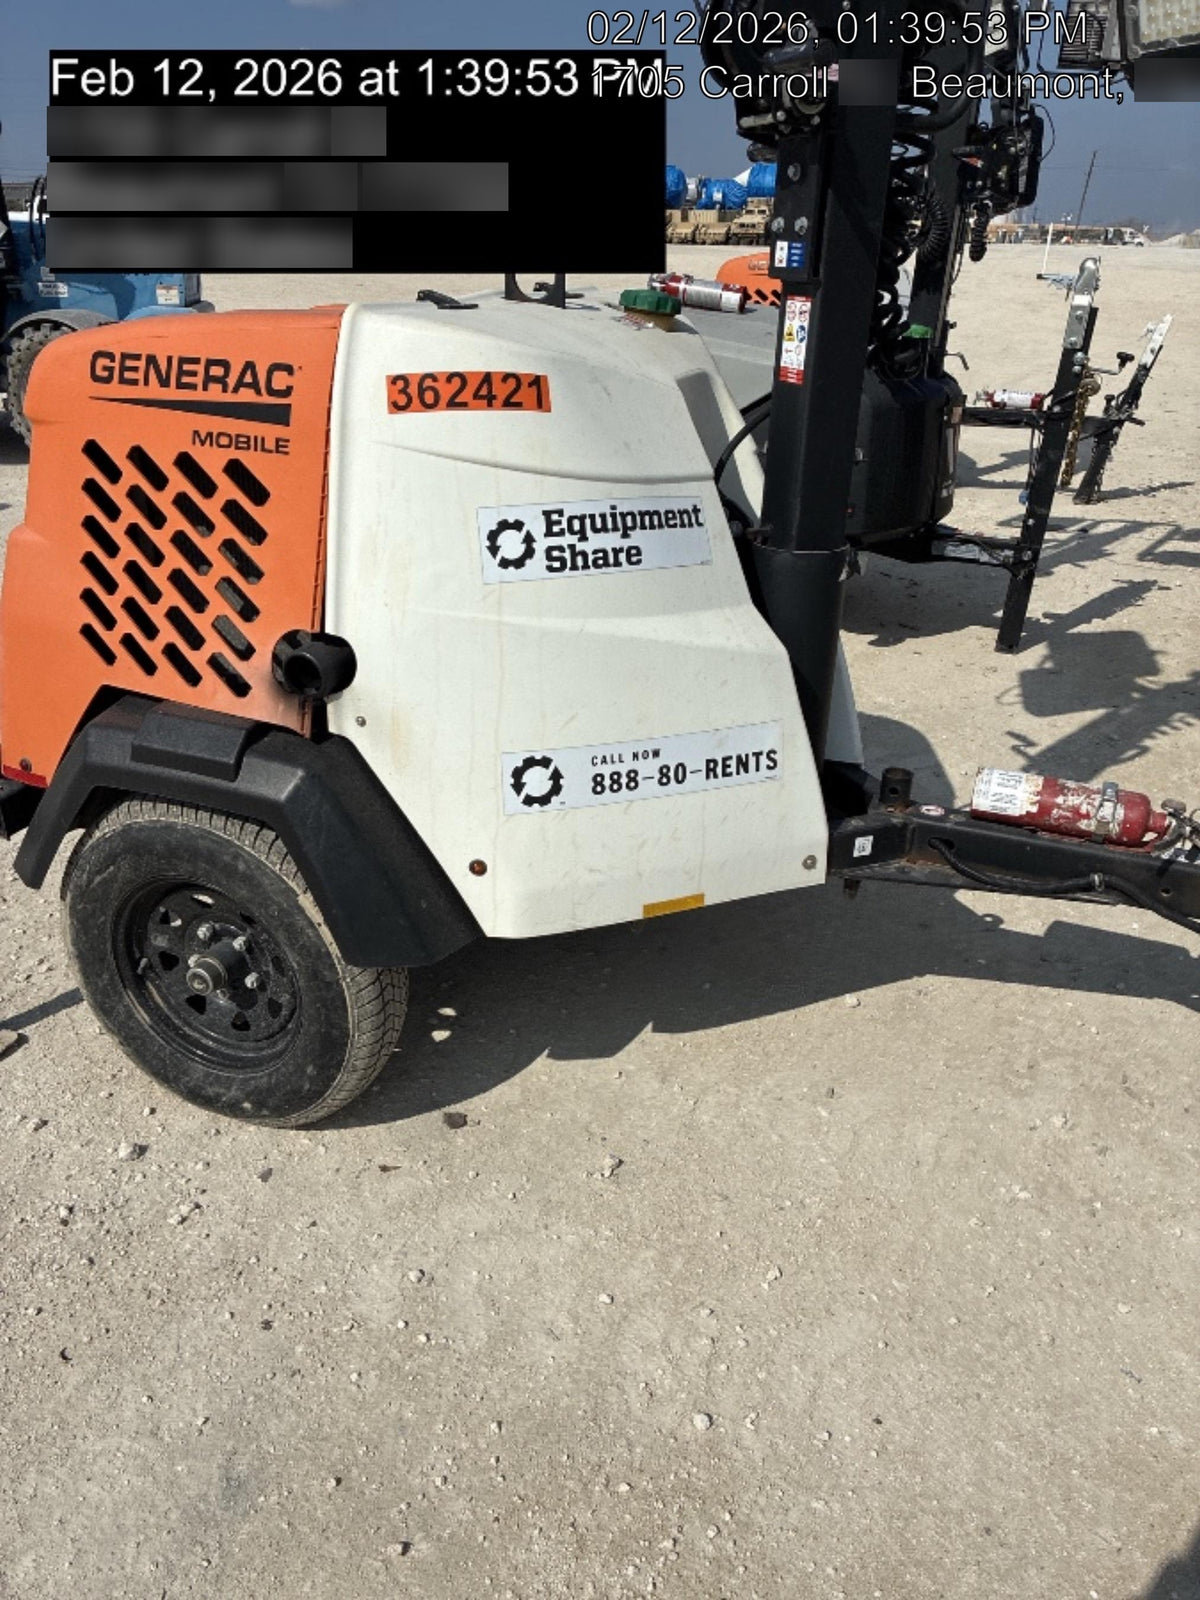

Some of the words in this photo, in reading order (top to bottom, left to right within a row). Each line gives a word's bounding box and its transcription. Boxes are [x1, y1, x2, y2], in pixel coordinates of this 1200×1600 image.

[90, 350, 295, 398] GENERAC
[390, 371, 544, 411] 362421
[191, 429, 290, 455] MOBILE
[541, 504, 704, 542] Equipment
[544, 543, 643, 573] Share
[590, 753, 625, 767] CALL
[631, 749, 662, 763] NOW
[590, 749, 779, 796] 888-80-RENTS
